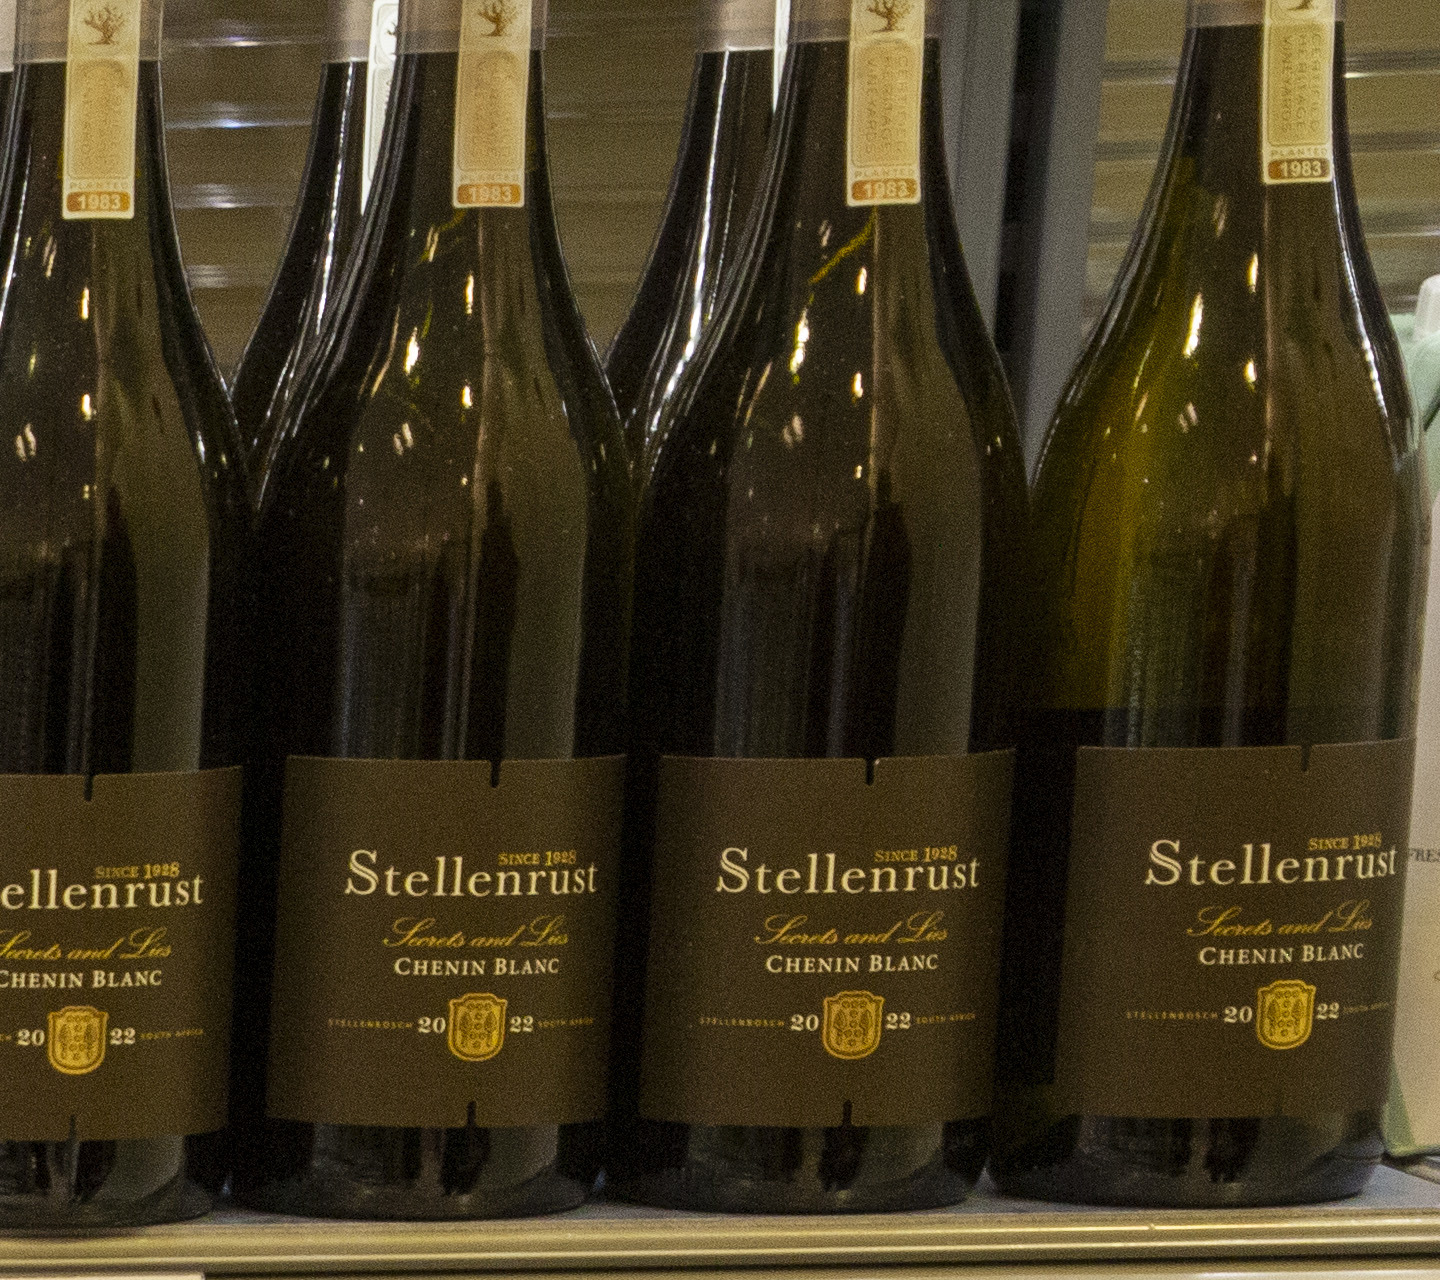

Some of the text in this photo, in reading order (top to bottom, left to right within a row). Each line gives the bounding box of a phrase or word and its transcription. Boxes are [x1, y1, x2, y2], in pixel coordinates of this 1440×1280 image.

[1280, 161, 1321, 177] 1983
[344, 850, 598, 897] Stellenrust
[715, 846, 980, 895] Stellenrust
[1145, 838, 1398, 886] Stellenrust
[766, 953, 939, 974] CHENIN BLANC
[1198, 942, 1364, 966] CHENIN BLANC
